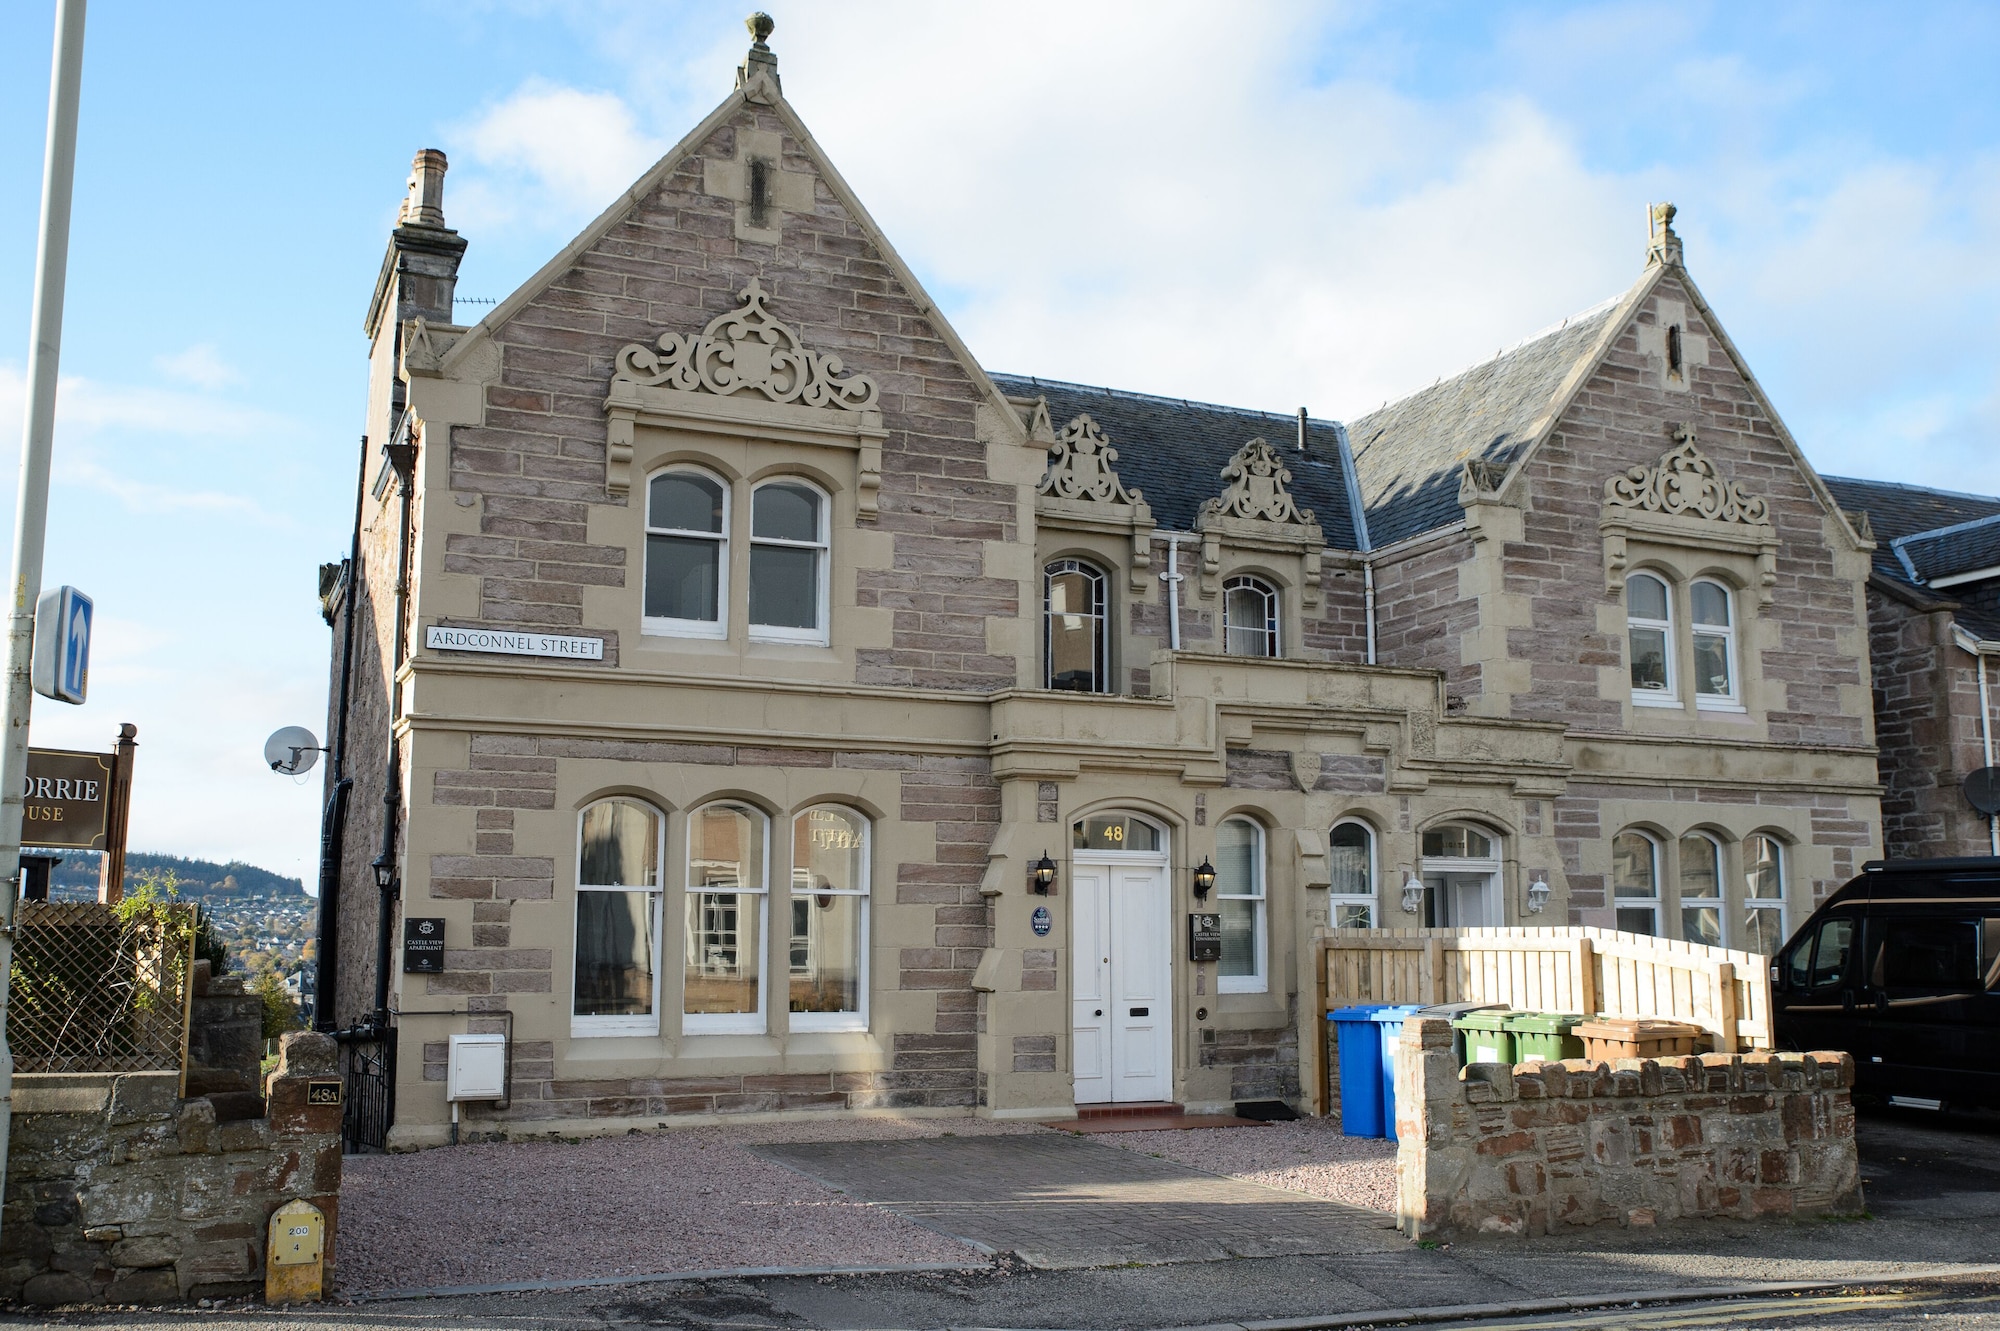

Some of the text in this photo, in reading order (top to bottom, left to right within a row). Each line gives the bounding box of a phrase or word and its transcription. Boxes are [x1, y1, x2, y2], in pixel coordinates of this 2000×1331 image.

[432, 631, 598, 655] ARDCONNEL STREET
[22, 805, 64, 822] USE
[1104, 825, 1123, 841] 48
[311, 1088, 337, 1102] 48A
[289, 1227, 308, 1236] 200
[294, 1243, 300, 1251] 4
